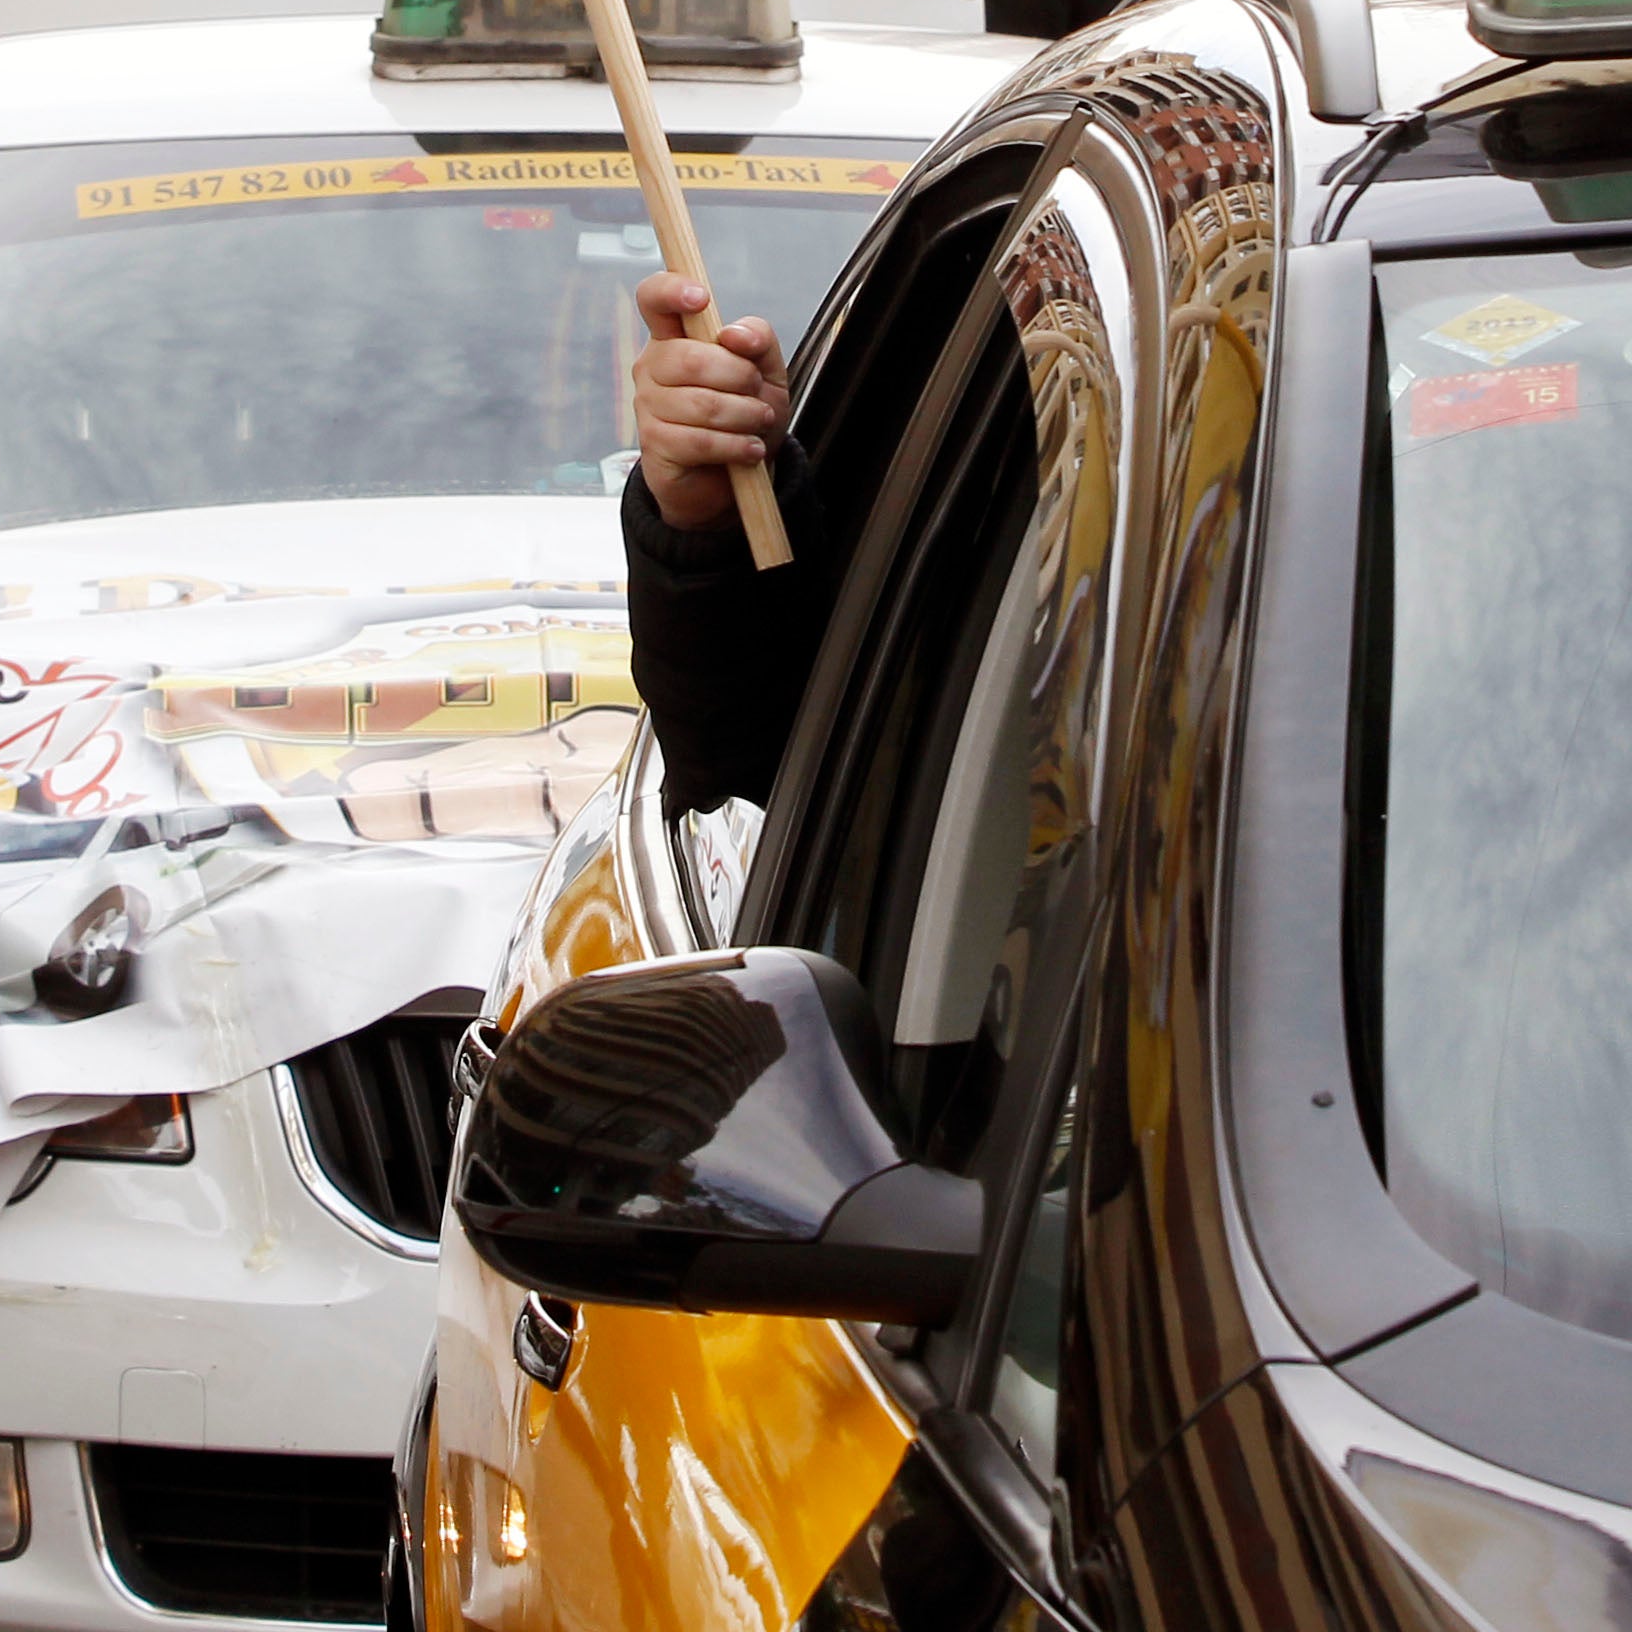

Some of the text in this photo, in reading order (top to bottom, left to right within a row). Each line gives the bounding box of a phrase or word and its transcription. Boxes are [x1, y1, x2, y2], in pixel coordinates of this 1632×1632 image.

[89, 156, 822, 210] 91 547 82 00 Radioteléno-Taxi
[1523, 386, 1560, 405] 15
